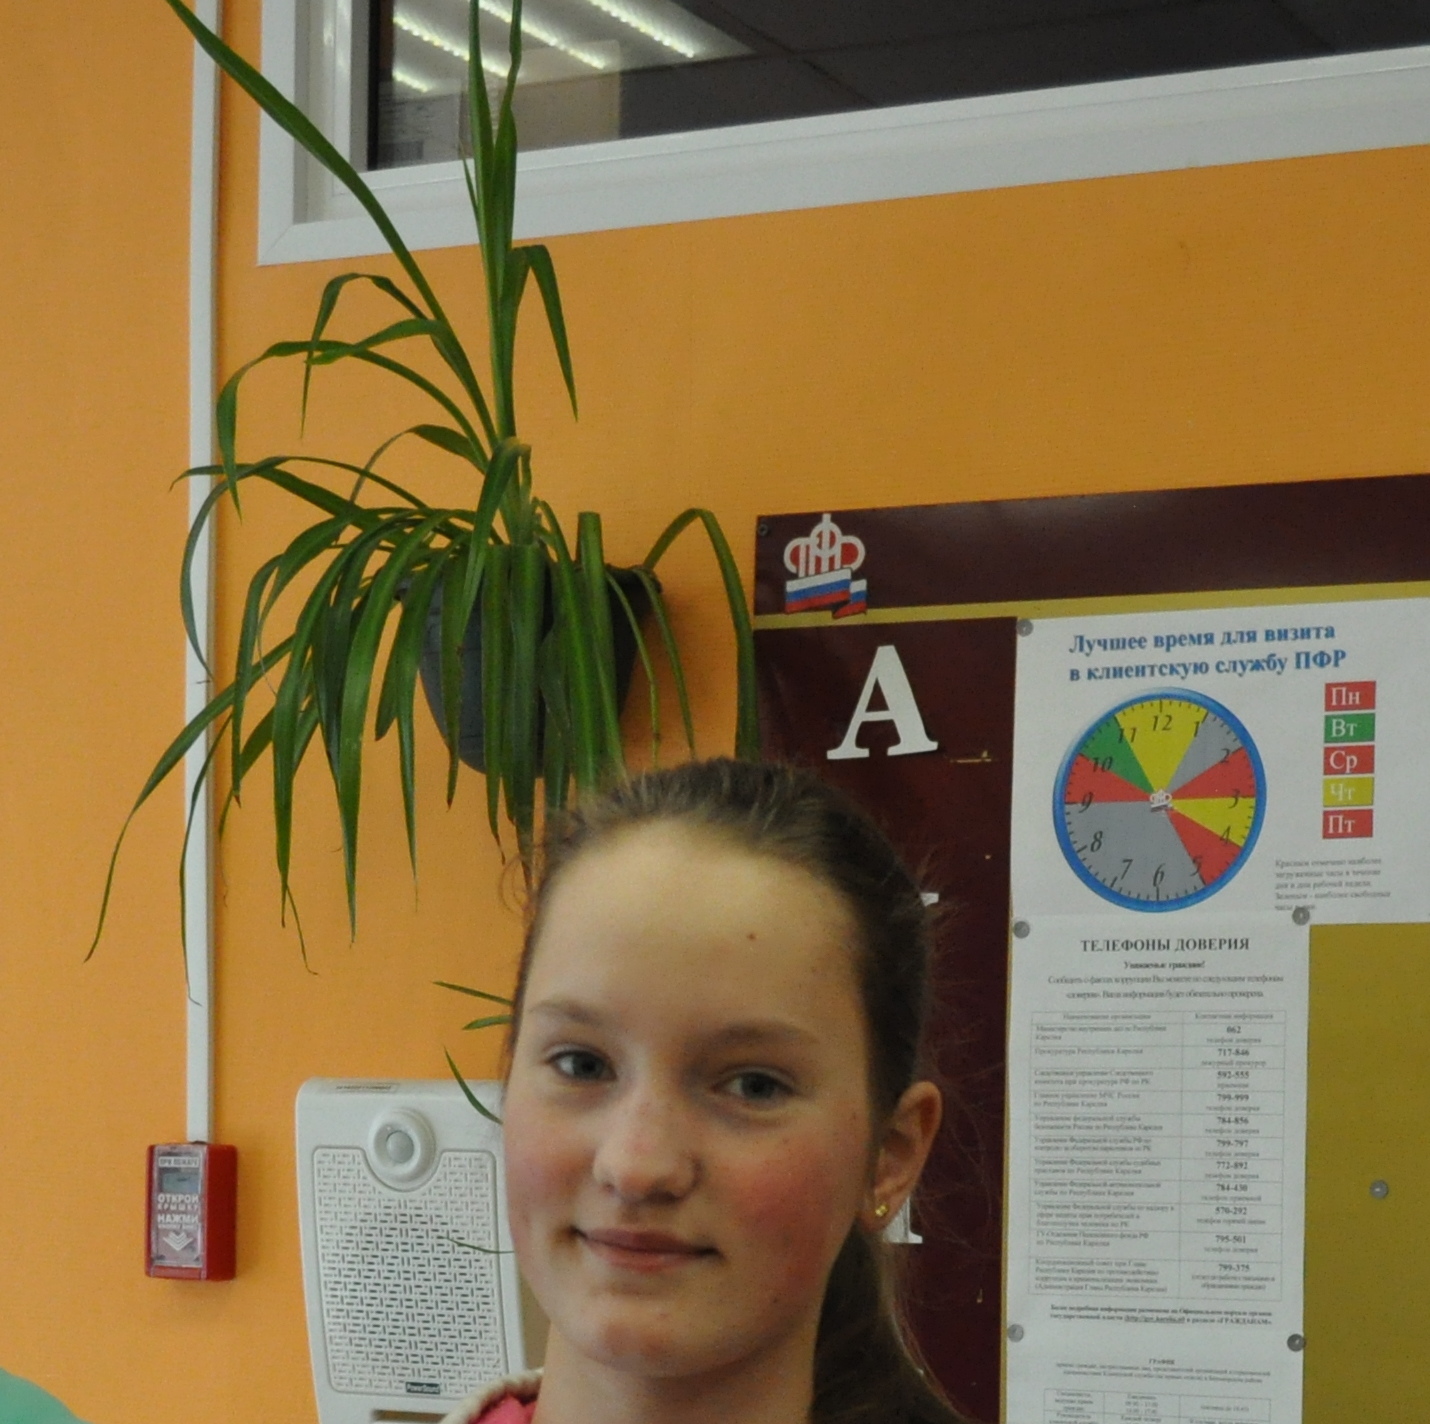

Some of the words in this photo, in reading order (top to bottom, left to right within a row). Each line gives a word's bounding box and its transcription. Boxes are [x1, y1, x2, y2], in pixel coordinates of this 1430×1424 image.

[1069, 634, 1148, 655] Лучшее
[1154, 631, 1215, 653] время
[1220, 629, 1258, 647] для
[1264, 625, 1336, 643] визита
[1070, 667, 1080, 682] в
[1086, 660, 1210, 682] клиентскую
[1215, 653, 1288, 677] службу
[1294, 649, 1347, 671] ПФР
[1330, 687, 1360, 706] Пн
[1151, 714, 1173, 733] 12
[1330, 718, 1358, 738] Вт
[1117, 728, 1138, 744] 11
[1091, 756, 1114, 773] 10
[1329, 751, 1358, 772] Ср
[1080, 792, 1094, 812] 9
[1229, 788, 1242, 808] 3
[1330, 781, 1357, 804] Чт
[1327, 813, 1356, 834] Пт
[1088, 830, 1103, 852] 8
[1219, 825, 1232, 845] 4
[1120, 859, 1134, 880] 7
[1152, 863, 1165, 887] 6
[1191, 855, 1203, 877] 5
[1080, 939, 1170, 952] ТЕЛЕФОНЫ
[1174, 938, 1250, 952] ДОВЕРИЯ
